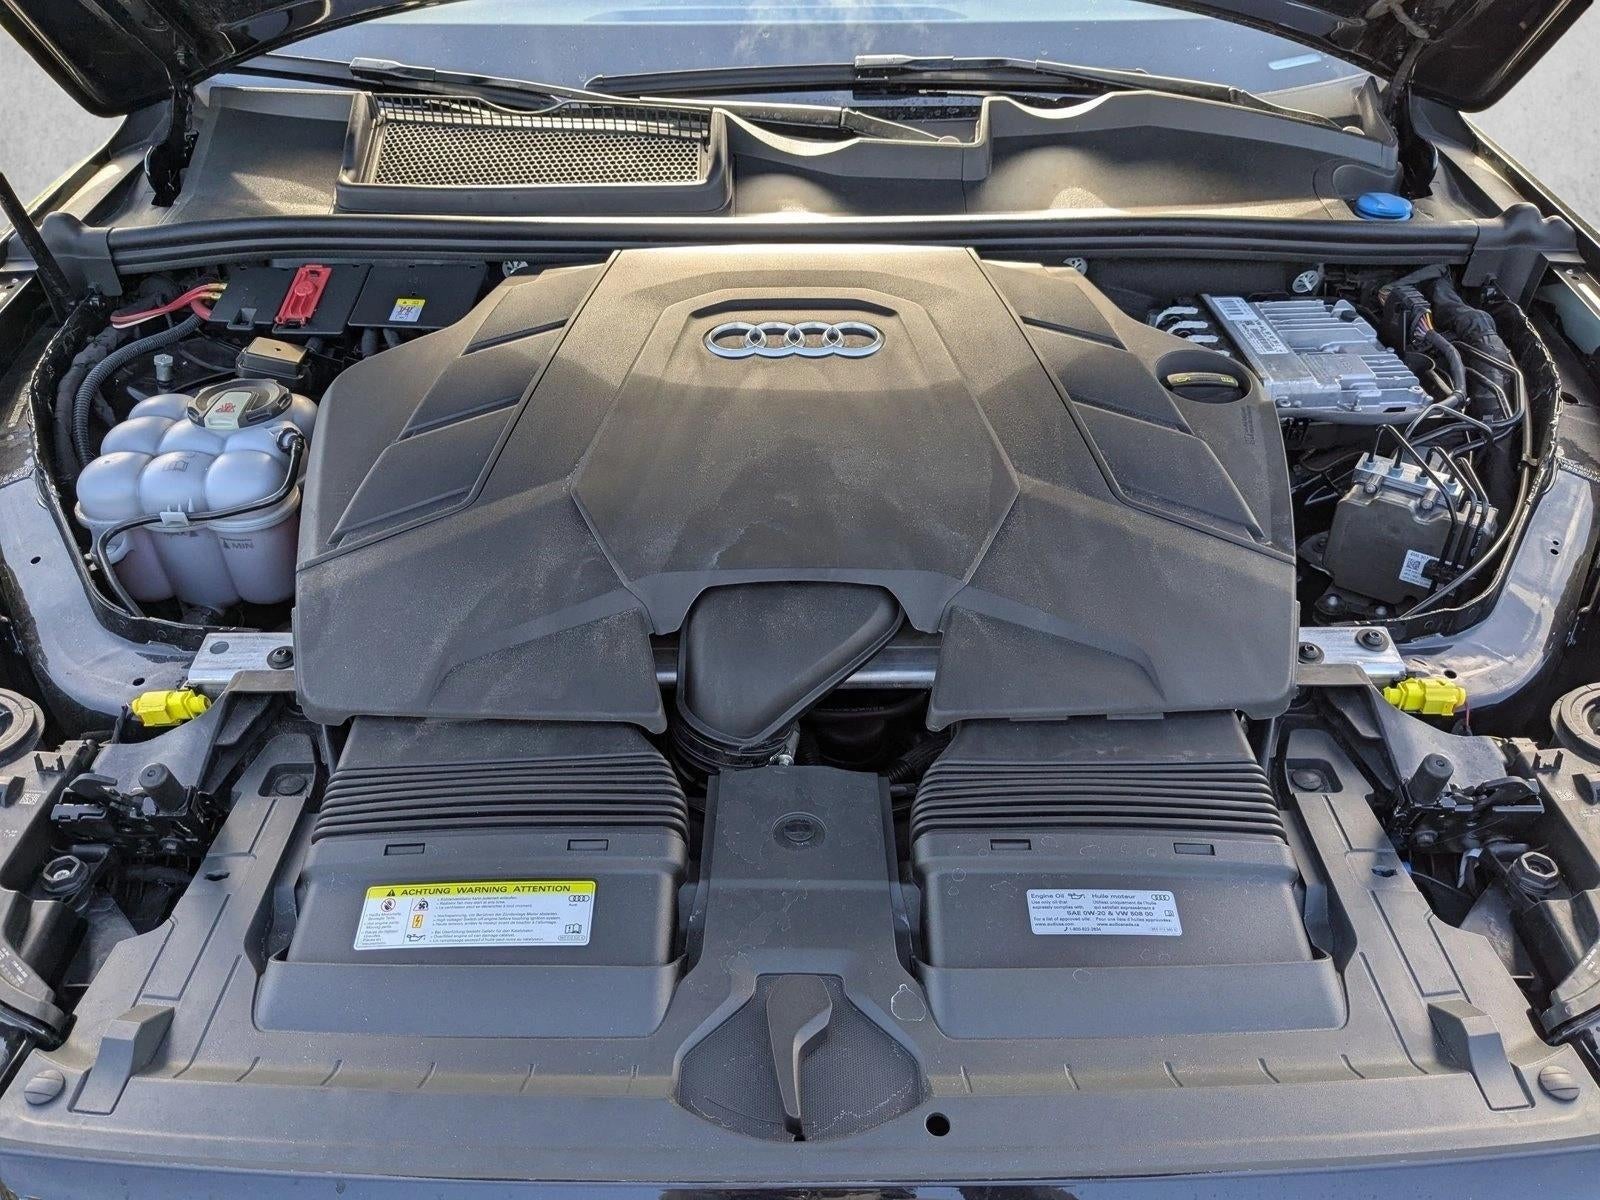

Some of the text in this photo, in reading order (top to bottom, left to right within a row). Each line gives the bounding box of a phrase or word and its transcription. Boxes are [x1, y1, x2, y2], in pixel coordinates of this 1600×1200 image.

[400, 884, 570, 896] ACHTUNG WARNING ATTENTION
